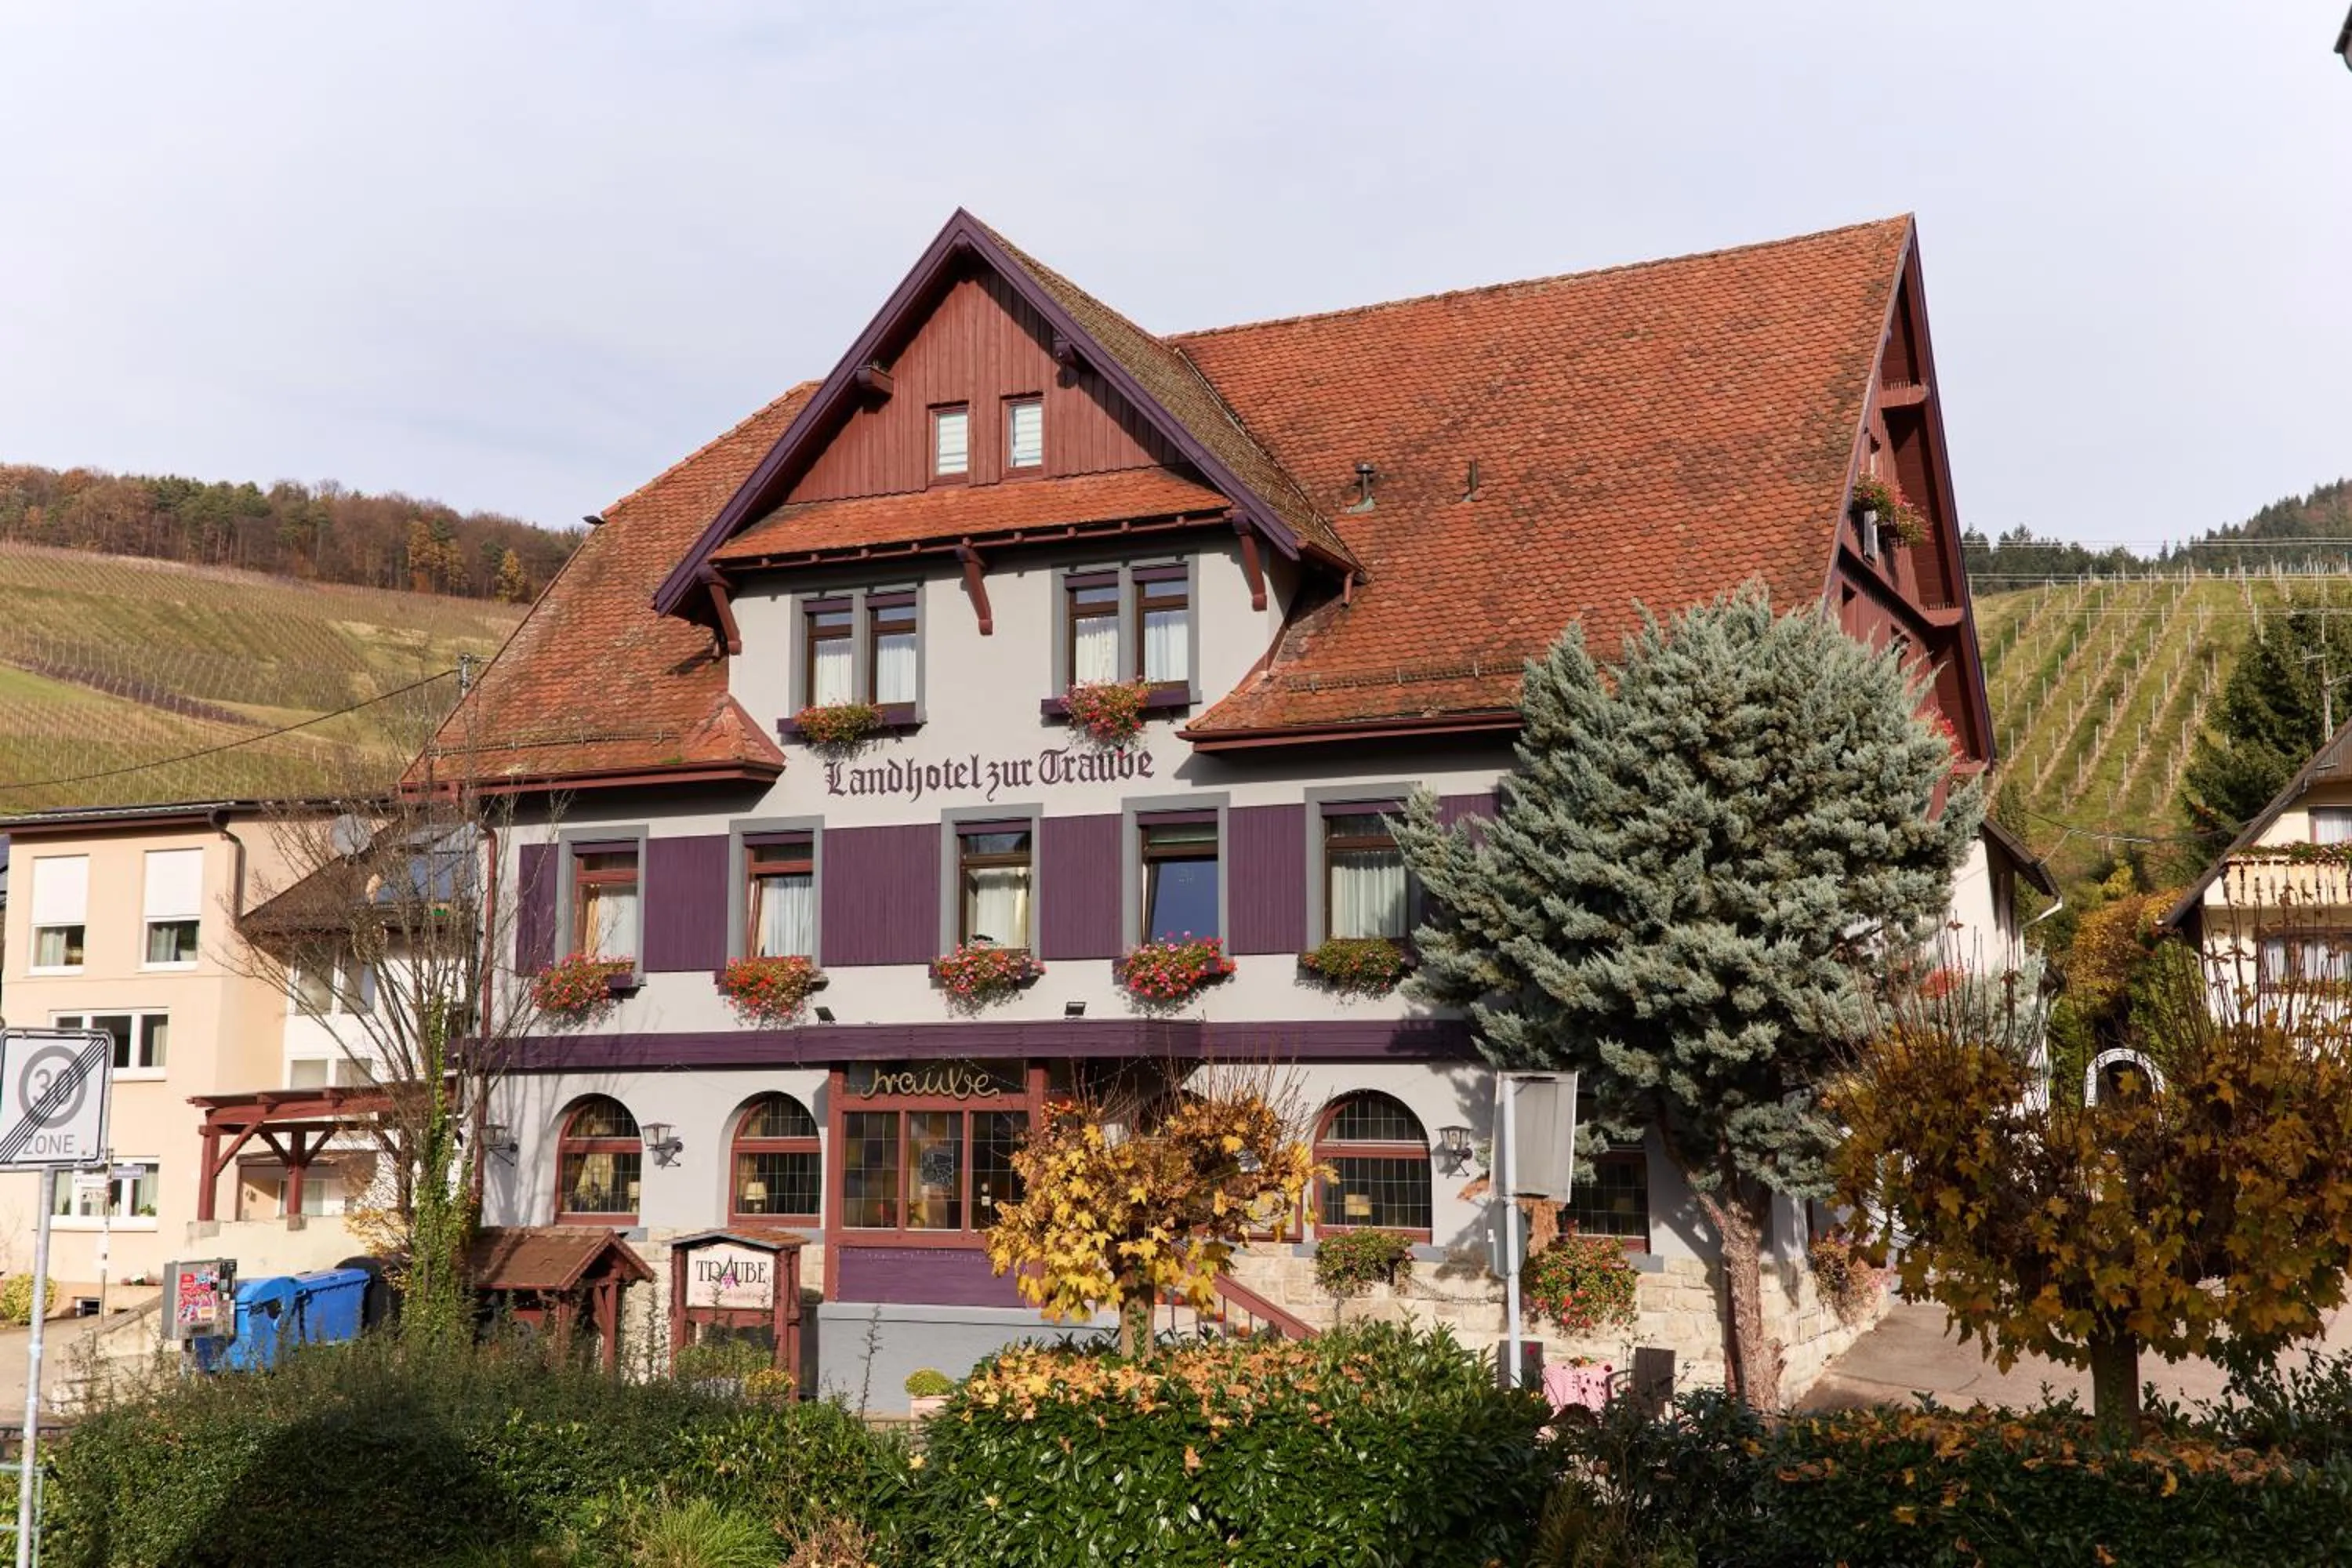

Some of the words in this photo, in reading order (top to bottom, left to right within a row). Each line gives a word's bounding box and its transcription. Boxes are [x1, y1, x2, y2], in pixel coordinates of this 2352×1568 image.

[823, 753, 983, 803] Landhotel
[985, 760, 1033, 802] zur
[1039, 746, 1155, 783] Traube
[23, 1134, 75, 1155] ZONE
[695, 1254, 767, 1287] TRAUBE
